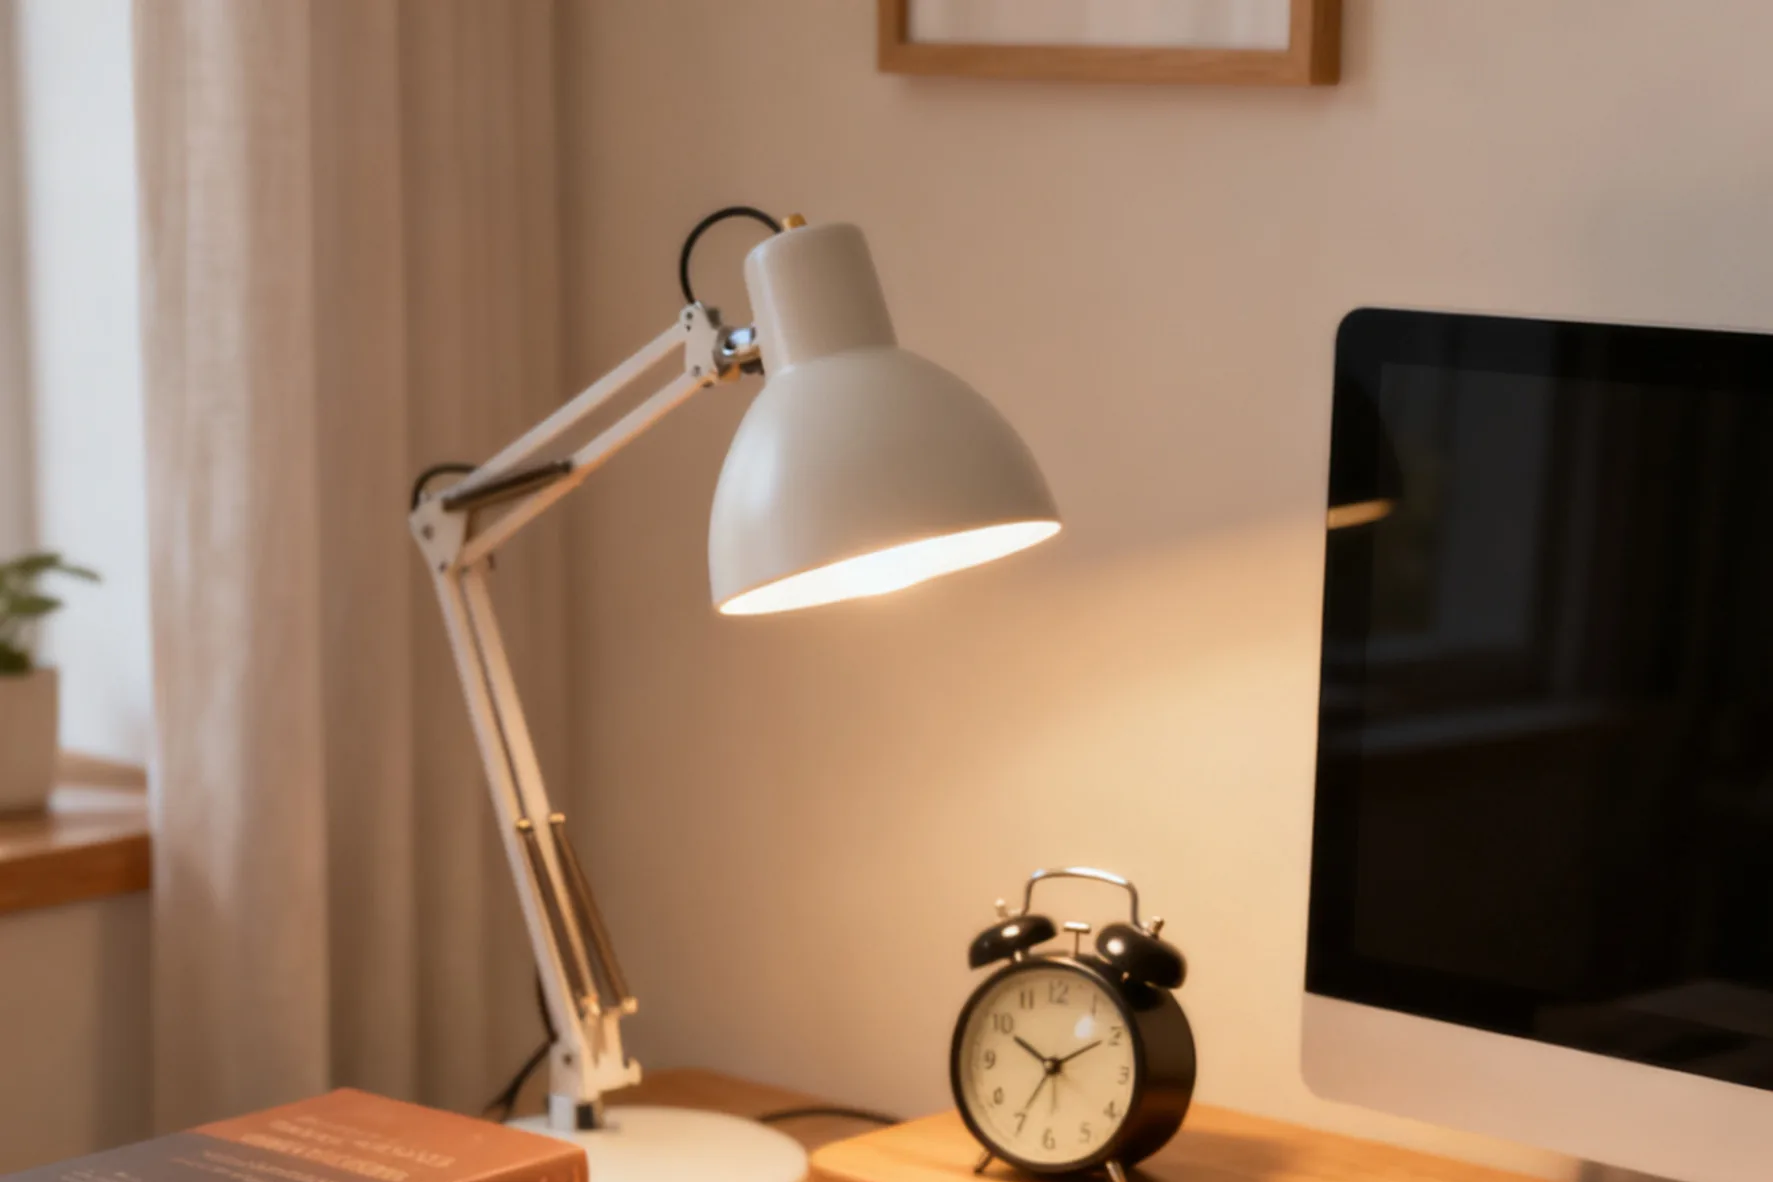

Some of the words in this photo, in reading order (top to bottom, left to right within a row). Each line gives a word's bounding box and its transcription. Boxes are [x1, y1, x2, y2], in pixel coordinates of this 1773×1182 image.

[1020, 989, 1034, 1010] 11
[1049, 979, 1069, 1004] 12
[993, 1013, 1013, 1034] 10
[1108, 1025, 1122, 1047] 2
[984, 1049, 996, 1069] 9
[1013, 1112, 1027, 1137] 7
[1079, 1122, 1092, 1144] 5
[1041, 1128, 1056, 1150] 6
